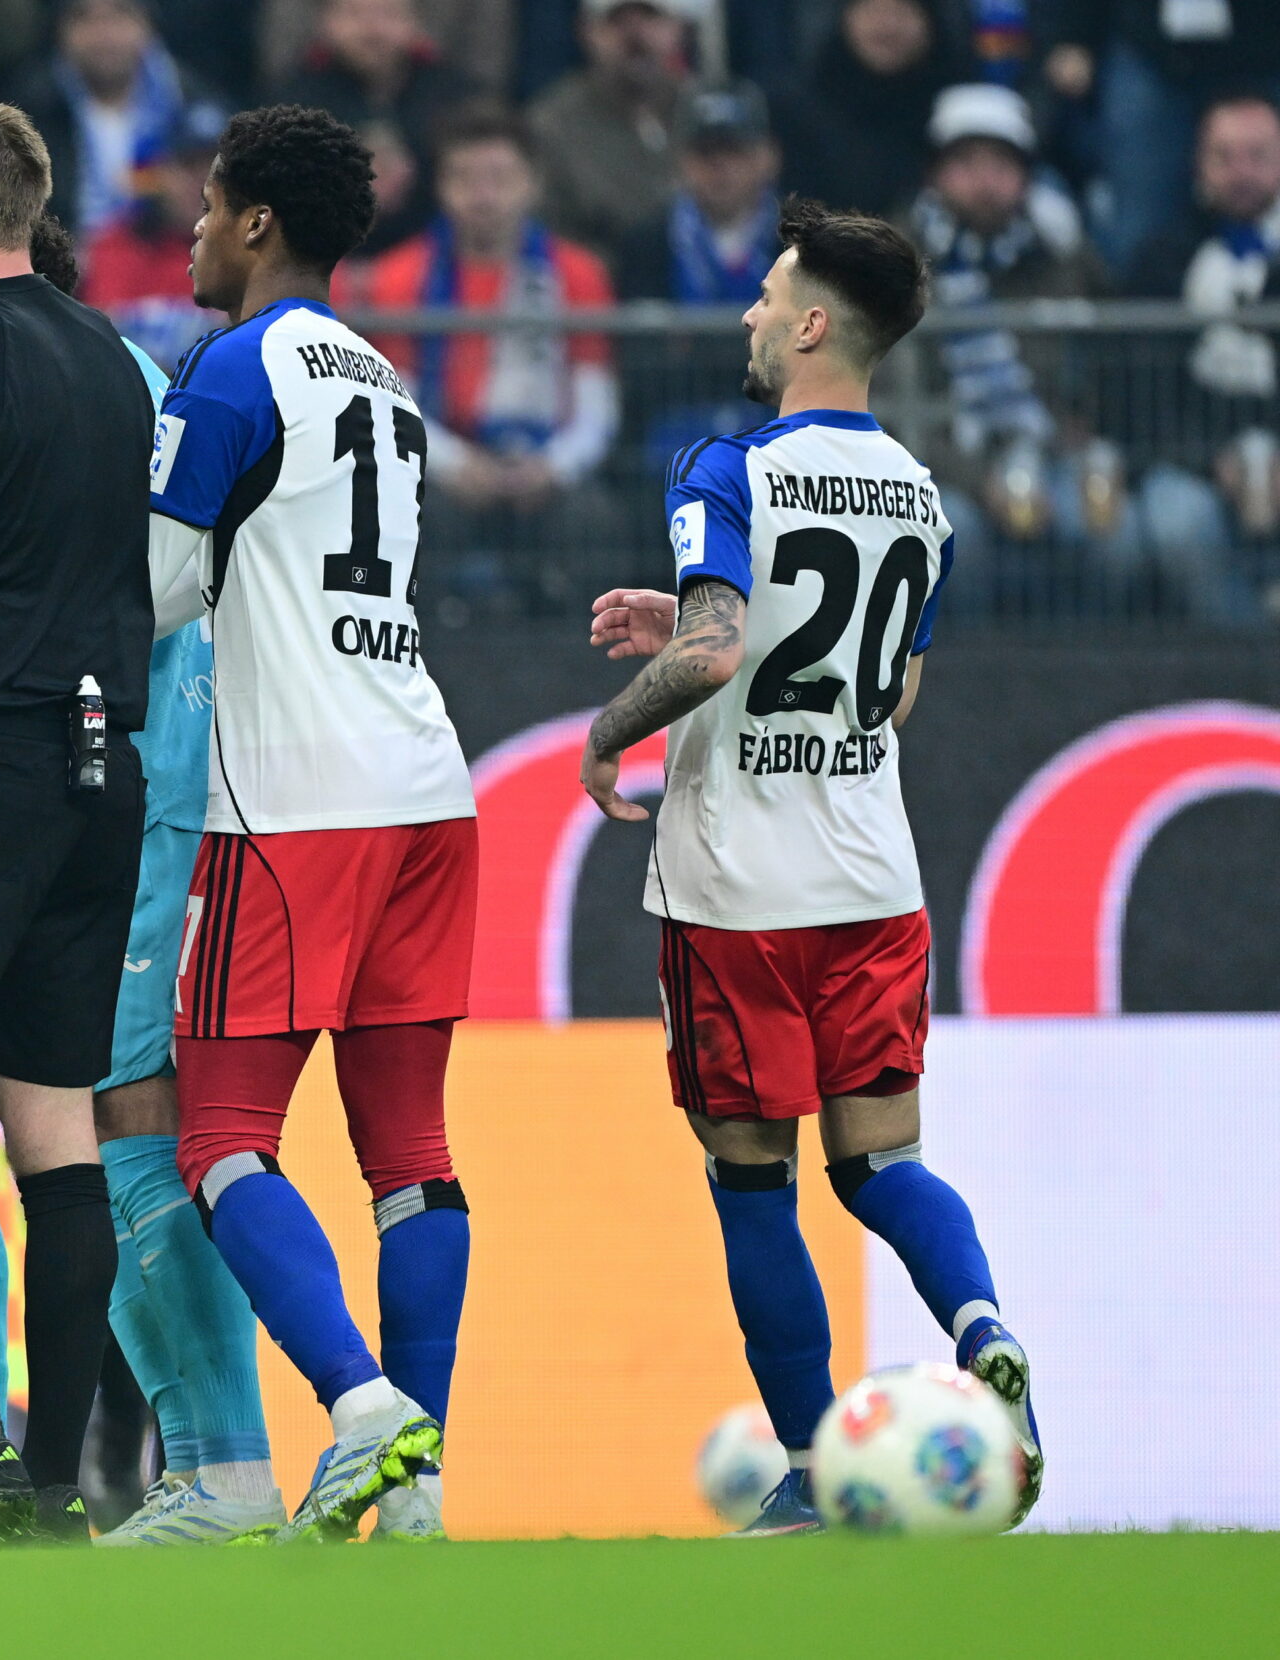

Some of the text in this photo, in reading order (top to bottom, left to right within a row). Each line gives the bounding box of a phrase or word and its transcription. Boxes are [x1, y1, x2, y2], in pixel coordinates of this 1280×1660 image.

[765, 472, 938, 527] HAMBURGER SV
[745, 527, 929, 731] 20
[738, 726, 826, 776] FÁBIO
